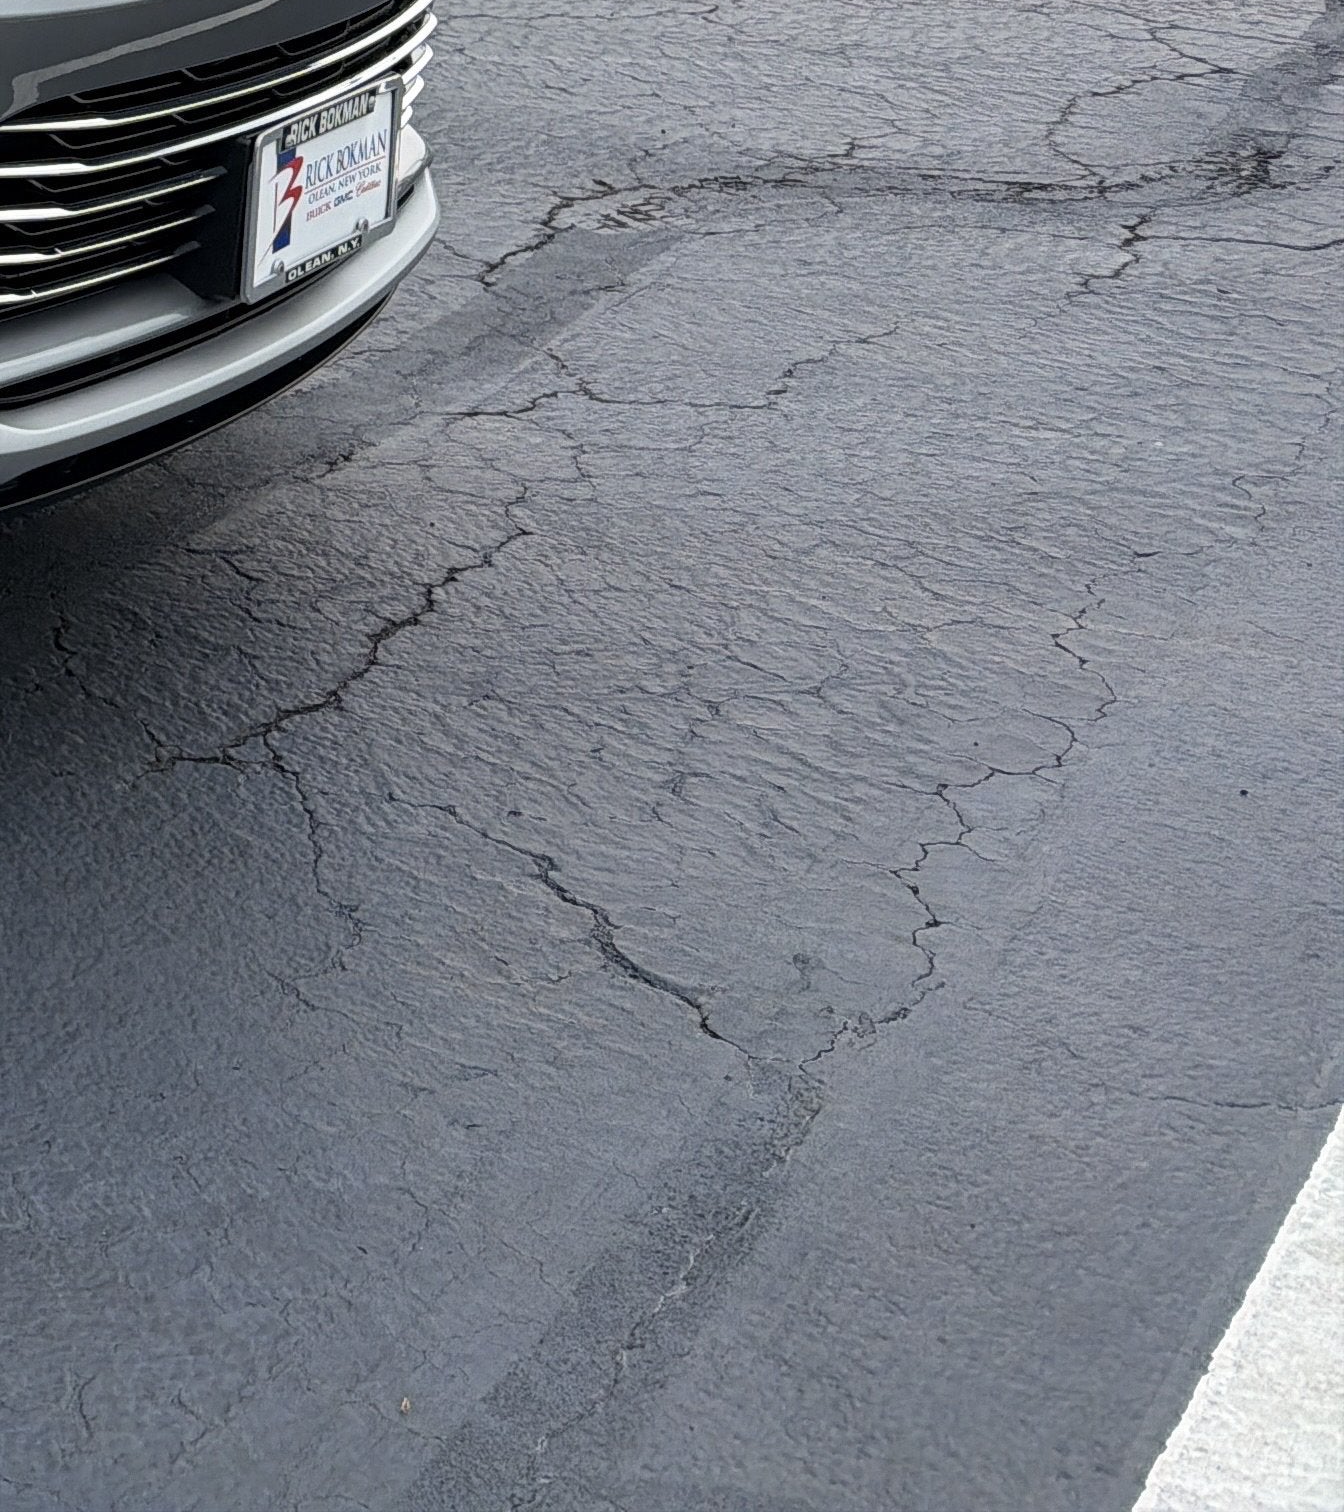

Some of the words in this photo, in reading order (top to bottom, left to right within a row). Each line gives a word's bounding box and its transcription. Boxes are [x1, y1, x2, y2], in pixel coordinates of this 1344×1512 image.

[289, 115, 317, 145] RICK
[319, 92, 369, 133] BOKMAN
[305, 154, 334, 189] RICK
[336, 129, 388, 173] BOKMAN
[338, 175, 357, 194] NEW
[358, 162, 382, 181] YORK
[306, 201, 332, 222] BUICK
[333, 190, 353, 206] GMC
